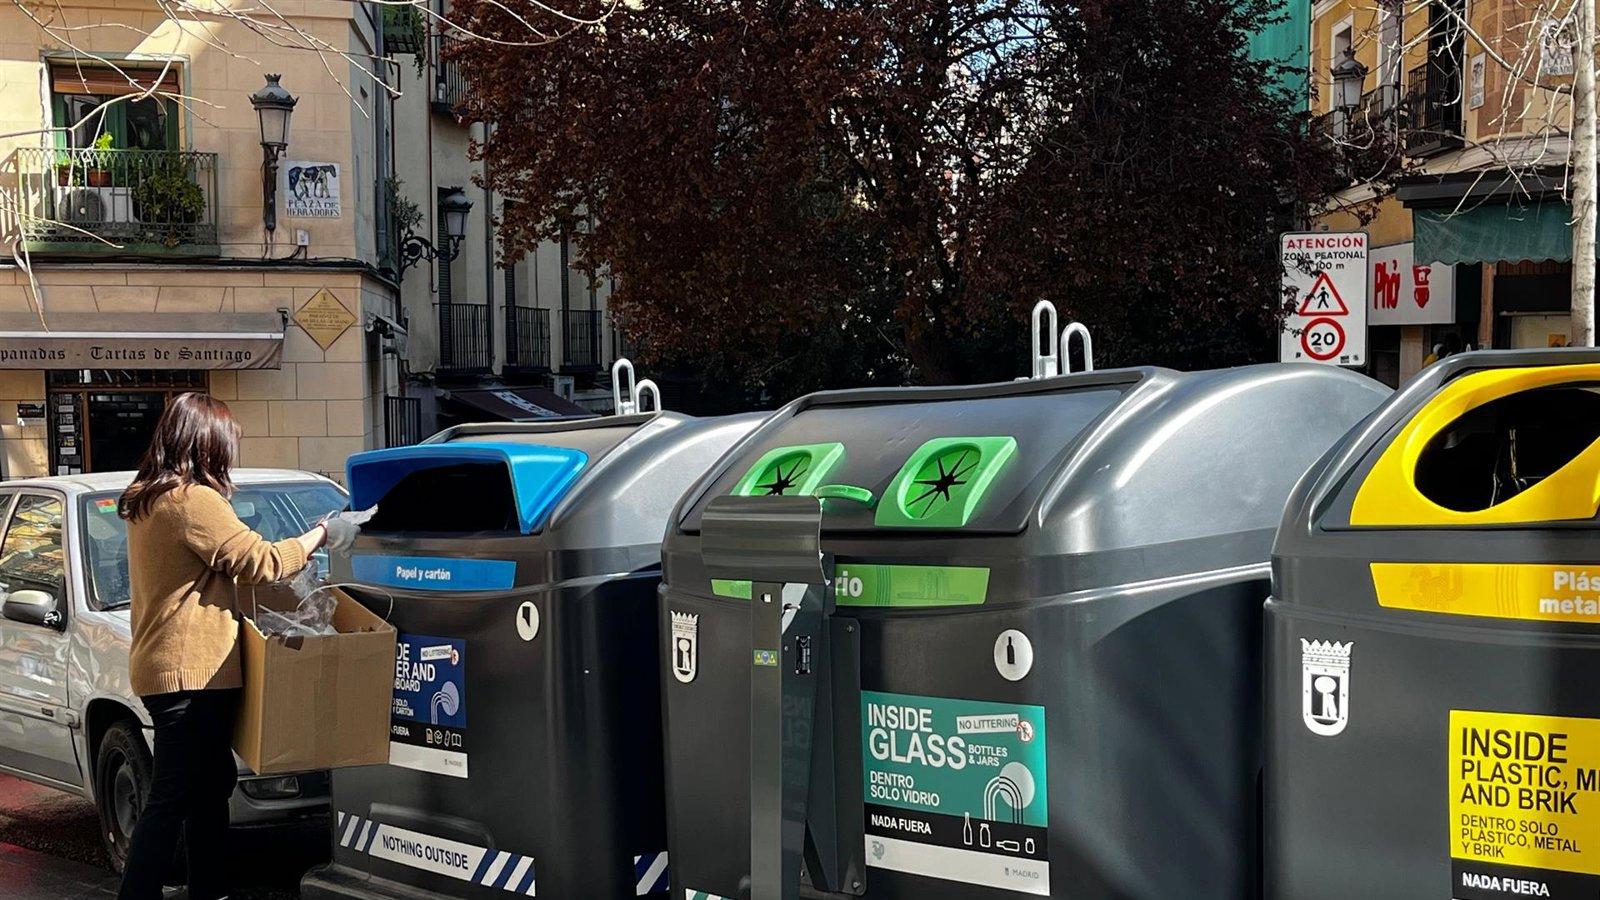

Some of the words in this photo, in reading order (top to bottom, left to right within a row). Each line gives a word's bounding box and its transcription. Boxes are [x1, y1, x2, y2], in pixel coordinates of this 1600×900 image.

[286, 208, 339, 216] HERRADORES
[288, 200, 321, 208] PLAZA
[1287, 236, 1364, 249] ATENCIÓN
[1315, 251, 1365, 260] PEATONAL
[1311, 332, 1335, 346] 20
[90, 346, 146, 360] Tartas
[154, 347, 170, 360] de
[178, 347, 251, 362] Santiago
[396, 566, 417, 580] Papel
[418, 570, 423, 581] y
[425, 568, 451, 581] cartón
[835, 570, 863, 597] rio
[412, 662, 436, 682] AND
[868, 703, 933, 733] INSIDE
[959, 719, 972, 730] NO
[973, 717, 1018, 729] LITTERING
[869, 728, 967, 770] GLASS
[968, 744, 1008, 758] BOTTLES
[1462, 727, 1568, 764] INSIDE
[977, 757, 1000, 767] JARS
[870, 770, 914, 788] DENTRO
[1461, 759, 1568, 790] PLASTIC,
[870, 785, 900, 800] SOLO
[902, 789, 940, 807] VIDRIO
[1460, 783, 1511, 808] AND
[1519, 787, 1578, 815] BRIK
[871, 814, 898, 830] NADA
[899, 818, 932, 835] FUERA
[1461, 813, 1516, 832] DENTRO
[1519, 819, 1559, 836] SOLO
[382, 834, 423, 857] NOTHING
[424, 846, 469, 870] OUTSIDE
[1461, 841, 1470, 854] Y
[1473, 842, 1505, 858] BRIK
[1534, 835, 1582, 853] METAL
[1012, 868, 1040, 879] MADRID
[1462, 872, 1501, 891] NADA
[1502, 877, 1551, 897] FUERA
